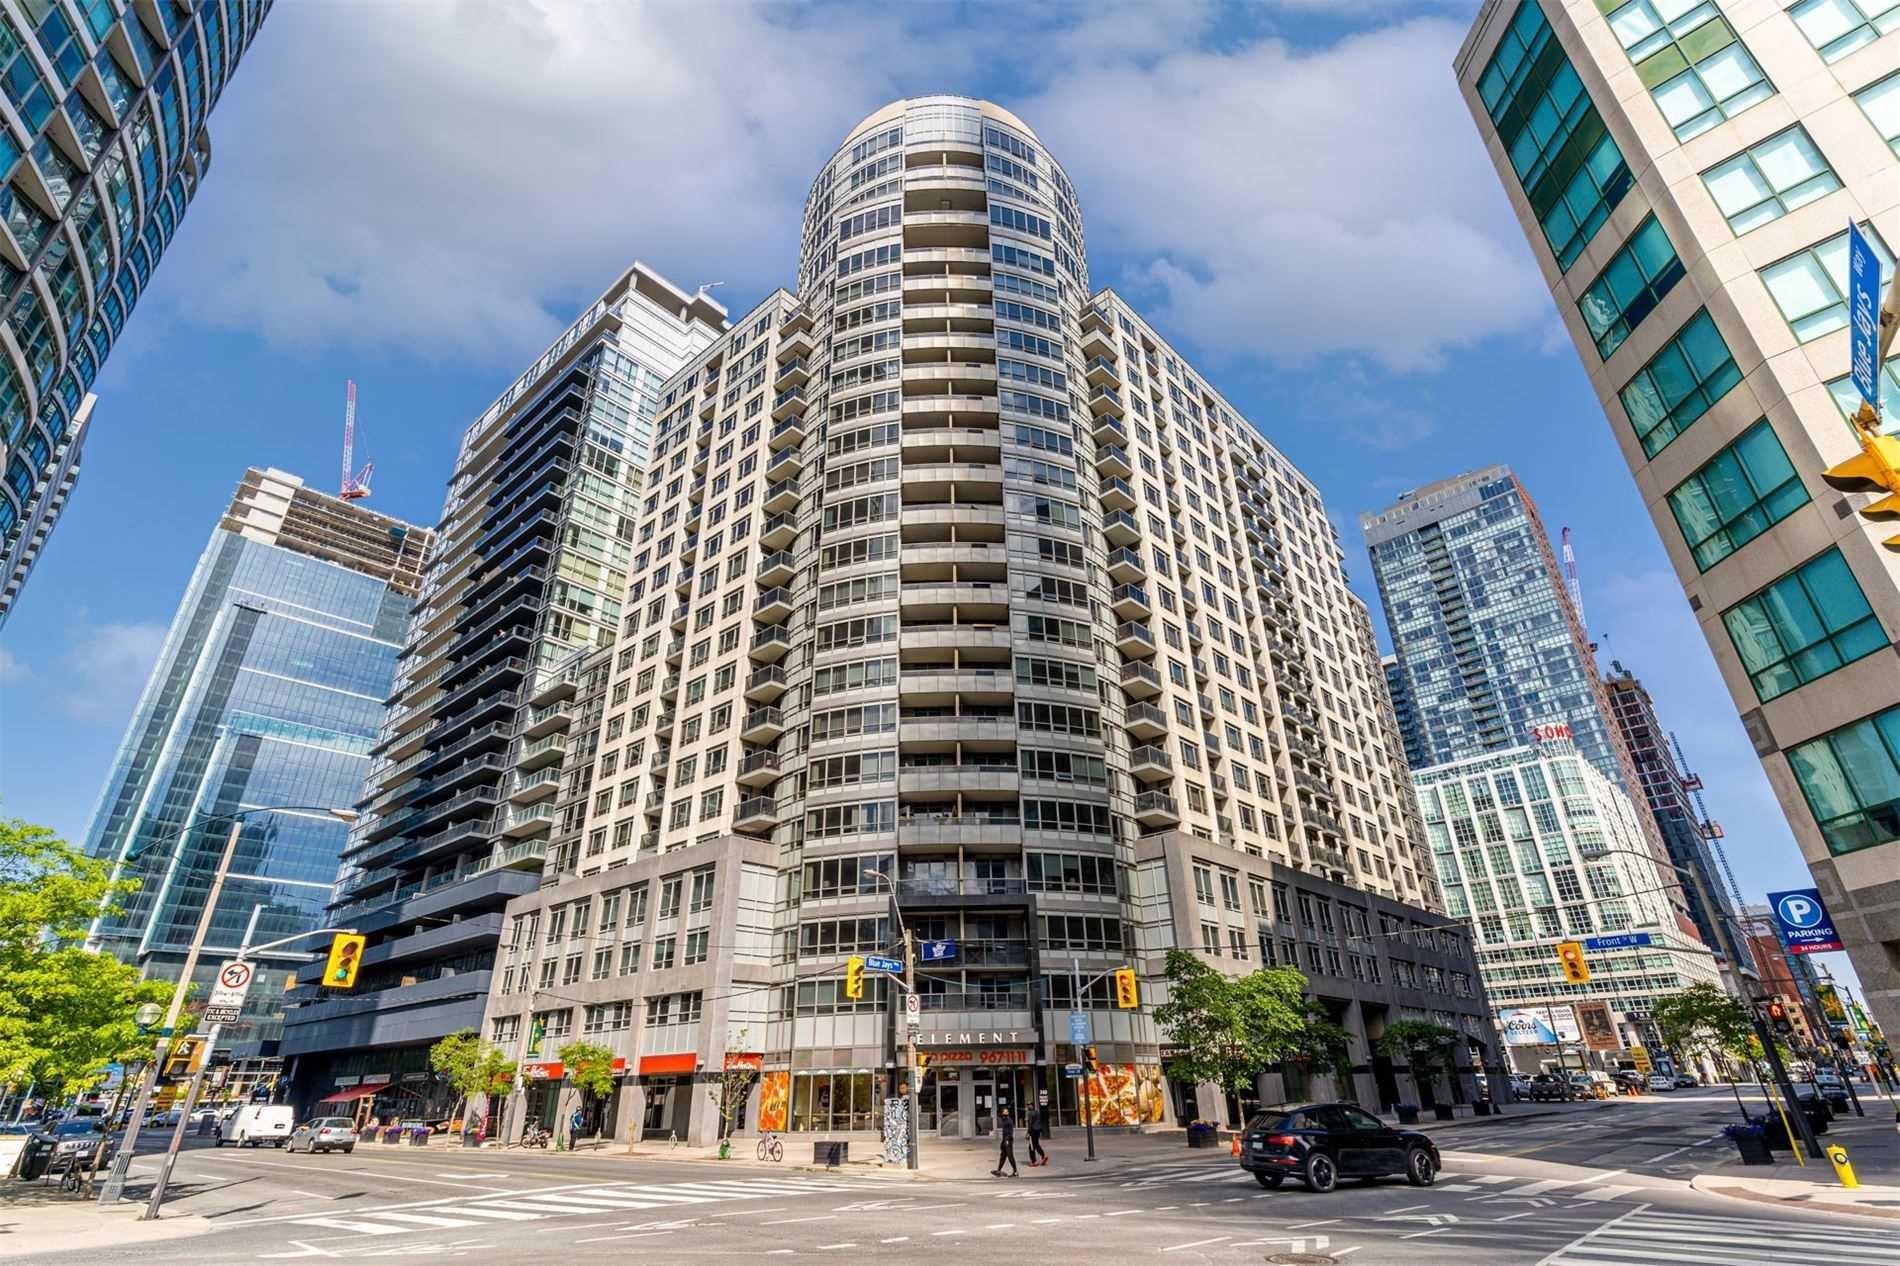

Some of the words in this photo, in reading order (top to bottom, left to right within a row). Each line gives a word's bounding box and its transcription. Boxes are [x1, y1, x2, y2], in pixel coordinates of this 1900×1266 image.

[1853, 283, 1876, 347] Jays
[1854, 341, 1873, 396] Blue
[1786, 899, 1811, 924] P
[1787, 928, 1832, 938] PARKING
[1597, 937, 1621, 947] Front
[1628, 935, 1638, 944] W
[1508, 1019, 1537, 1031] Coors
[916, 1032, 1018, 1045] ELEMENT
